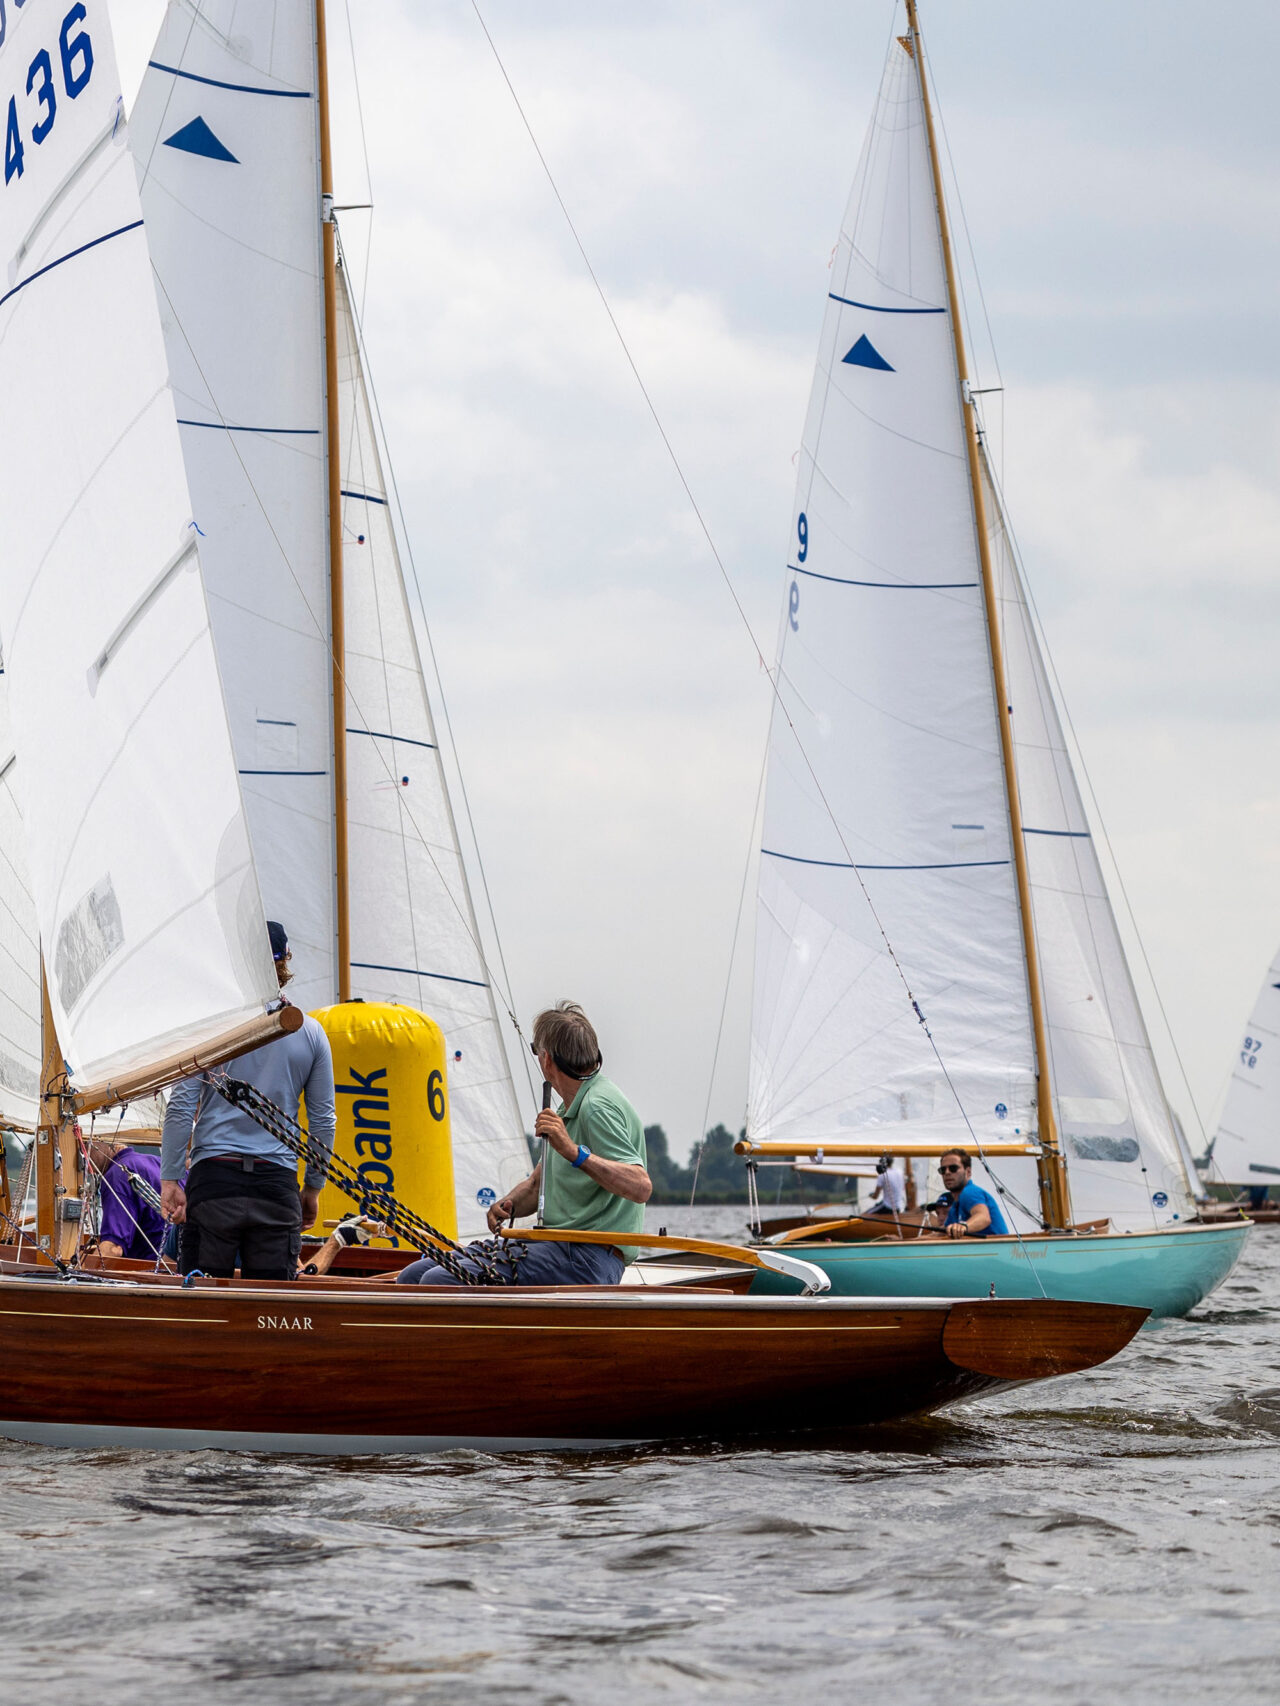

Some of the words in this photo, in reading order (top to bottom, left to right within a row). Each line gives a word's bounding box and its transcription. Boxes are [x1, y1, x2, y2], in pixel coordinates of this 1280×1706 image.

[5, 2, 94, 187] 436
[798, 512, 808, 562] 9
[1244, 1036, 1263, 1053] 97
[427, 1069, 445, 1122] 6
[257, 1315, 314, 1330] SNAAR
